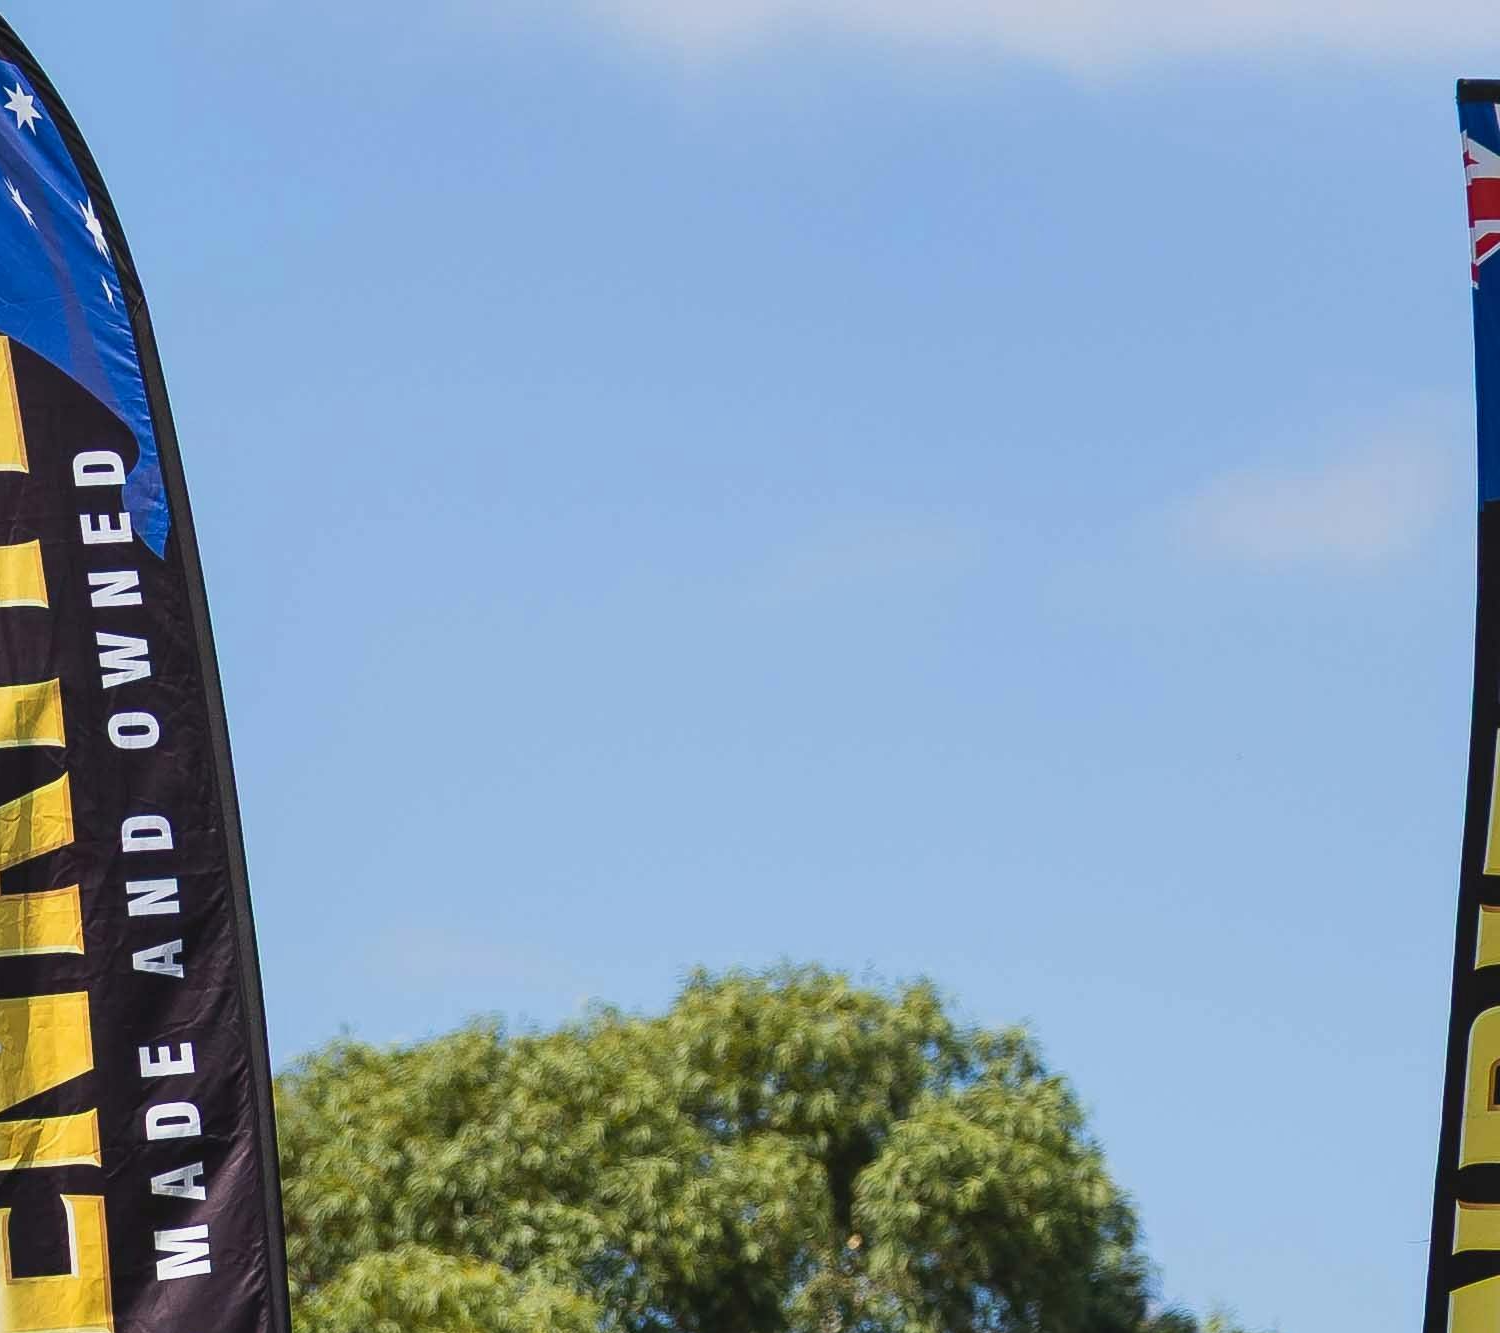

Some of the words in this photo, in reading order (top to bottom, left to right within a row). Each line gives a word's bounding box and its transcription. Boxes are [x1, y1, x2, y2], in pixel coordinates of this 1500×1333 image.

[72, 448, 161, 752] OWNED
[121, 812, 185, 980] AND
[139, 1040, 214, 1282] MADE
